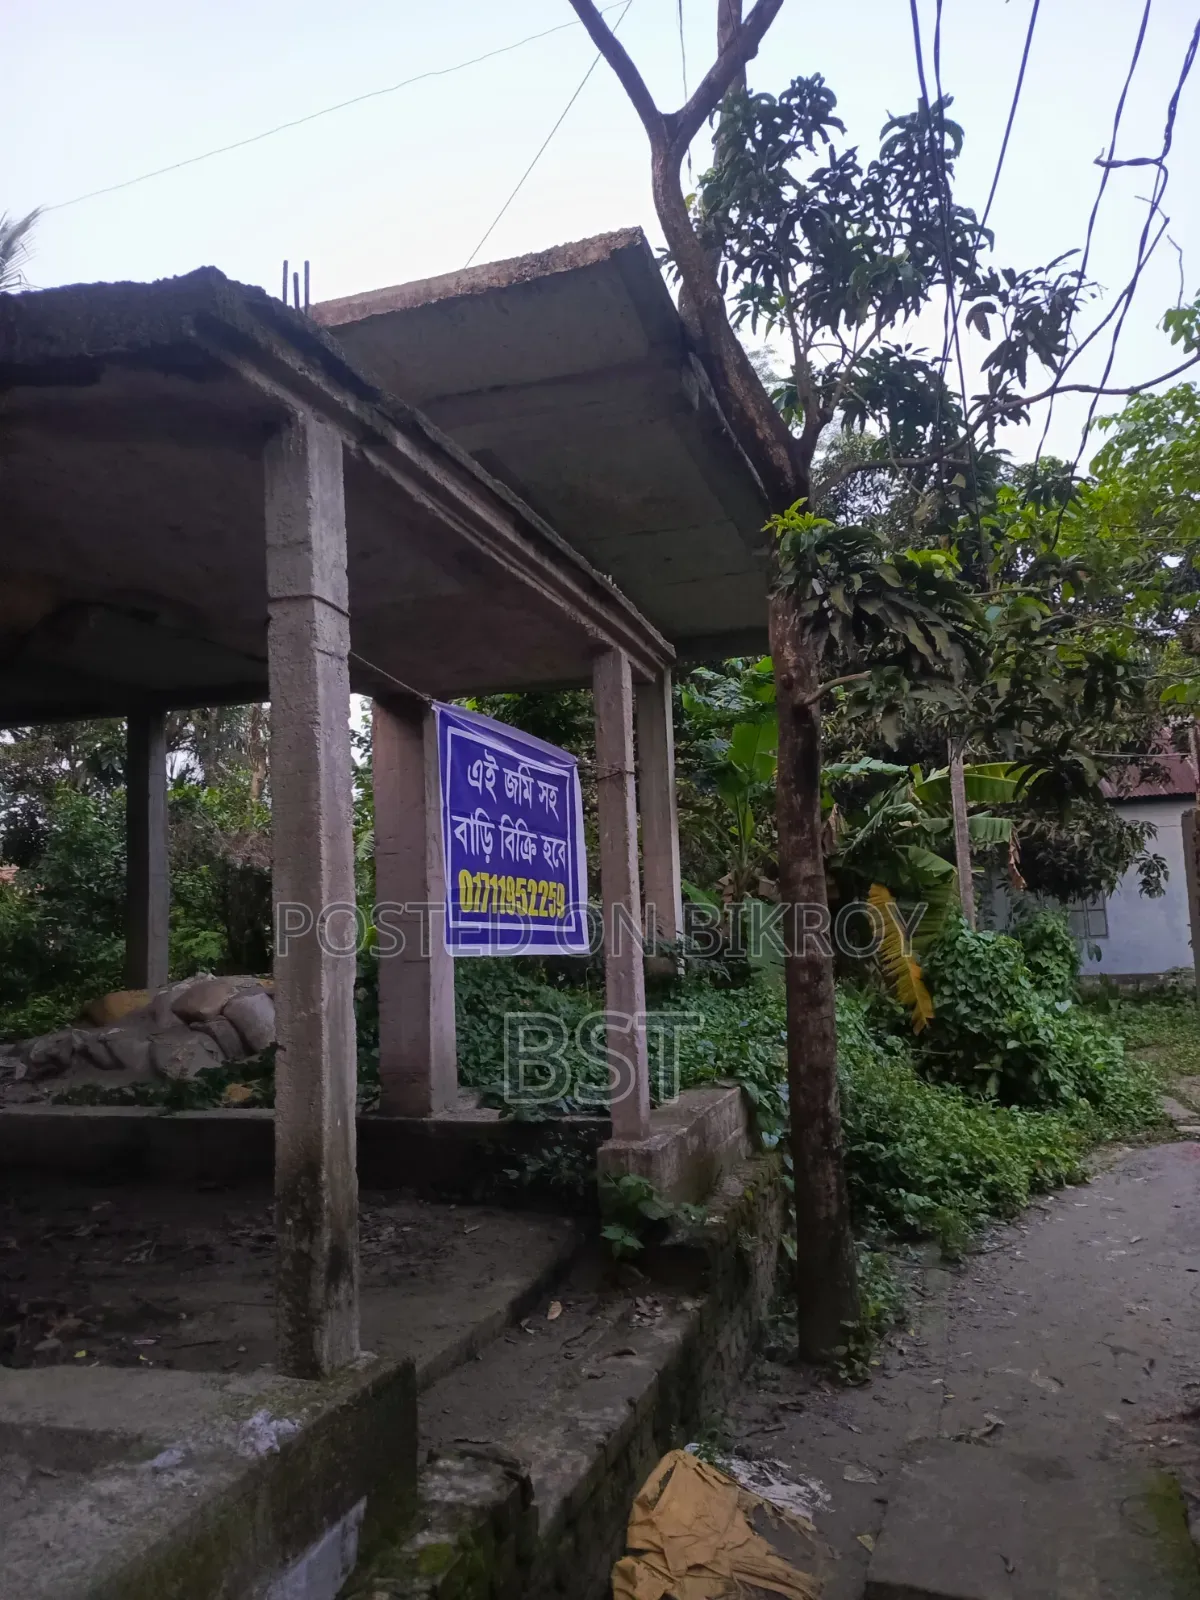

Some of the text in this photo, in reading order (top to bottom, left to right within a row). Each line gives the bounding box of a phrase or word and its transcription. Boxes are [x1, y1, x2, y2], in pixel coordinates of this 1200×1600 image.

[467, 749, 560, 822] এই জমি সহ
[451, 807, 566, 874] বাড়ি বিক্রি হবে
[458, 869, 566, 919] 01711952259
